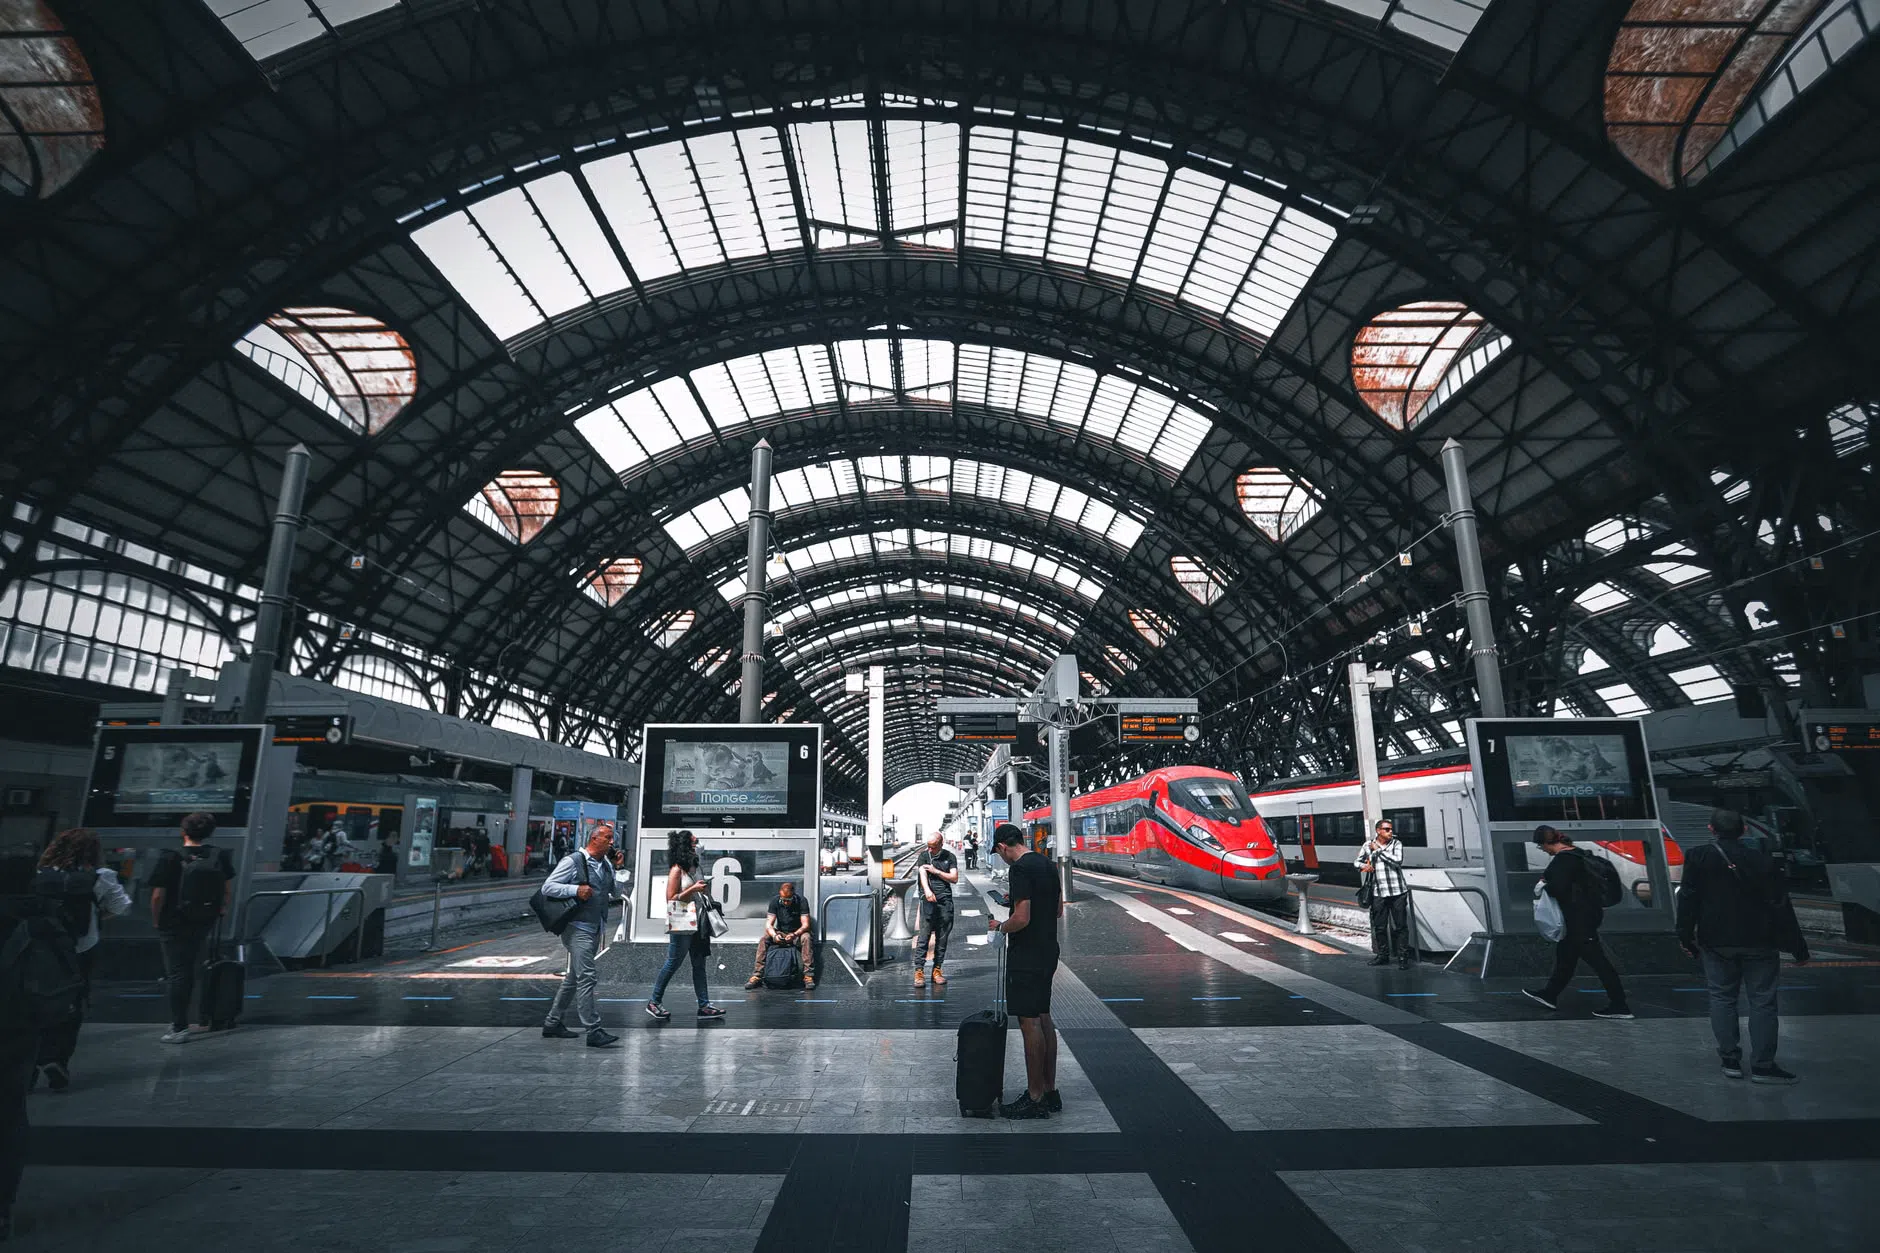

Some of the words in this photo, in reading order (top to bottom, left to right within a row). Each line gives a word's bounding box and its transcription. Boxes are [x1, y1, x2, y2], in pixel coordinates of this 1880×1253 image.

[941, 715, 947, 723] 6
[1190, 715, 1196, 723] 7
[103, 745, 116, 760] 5
[800, 745, 809, 759] 6
[1487, 739, 1495, 753] 7
[711, 857, 743, 912] 6
